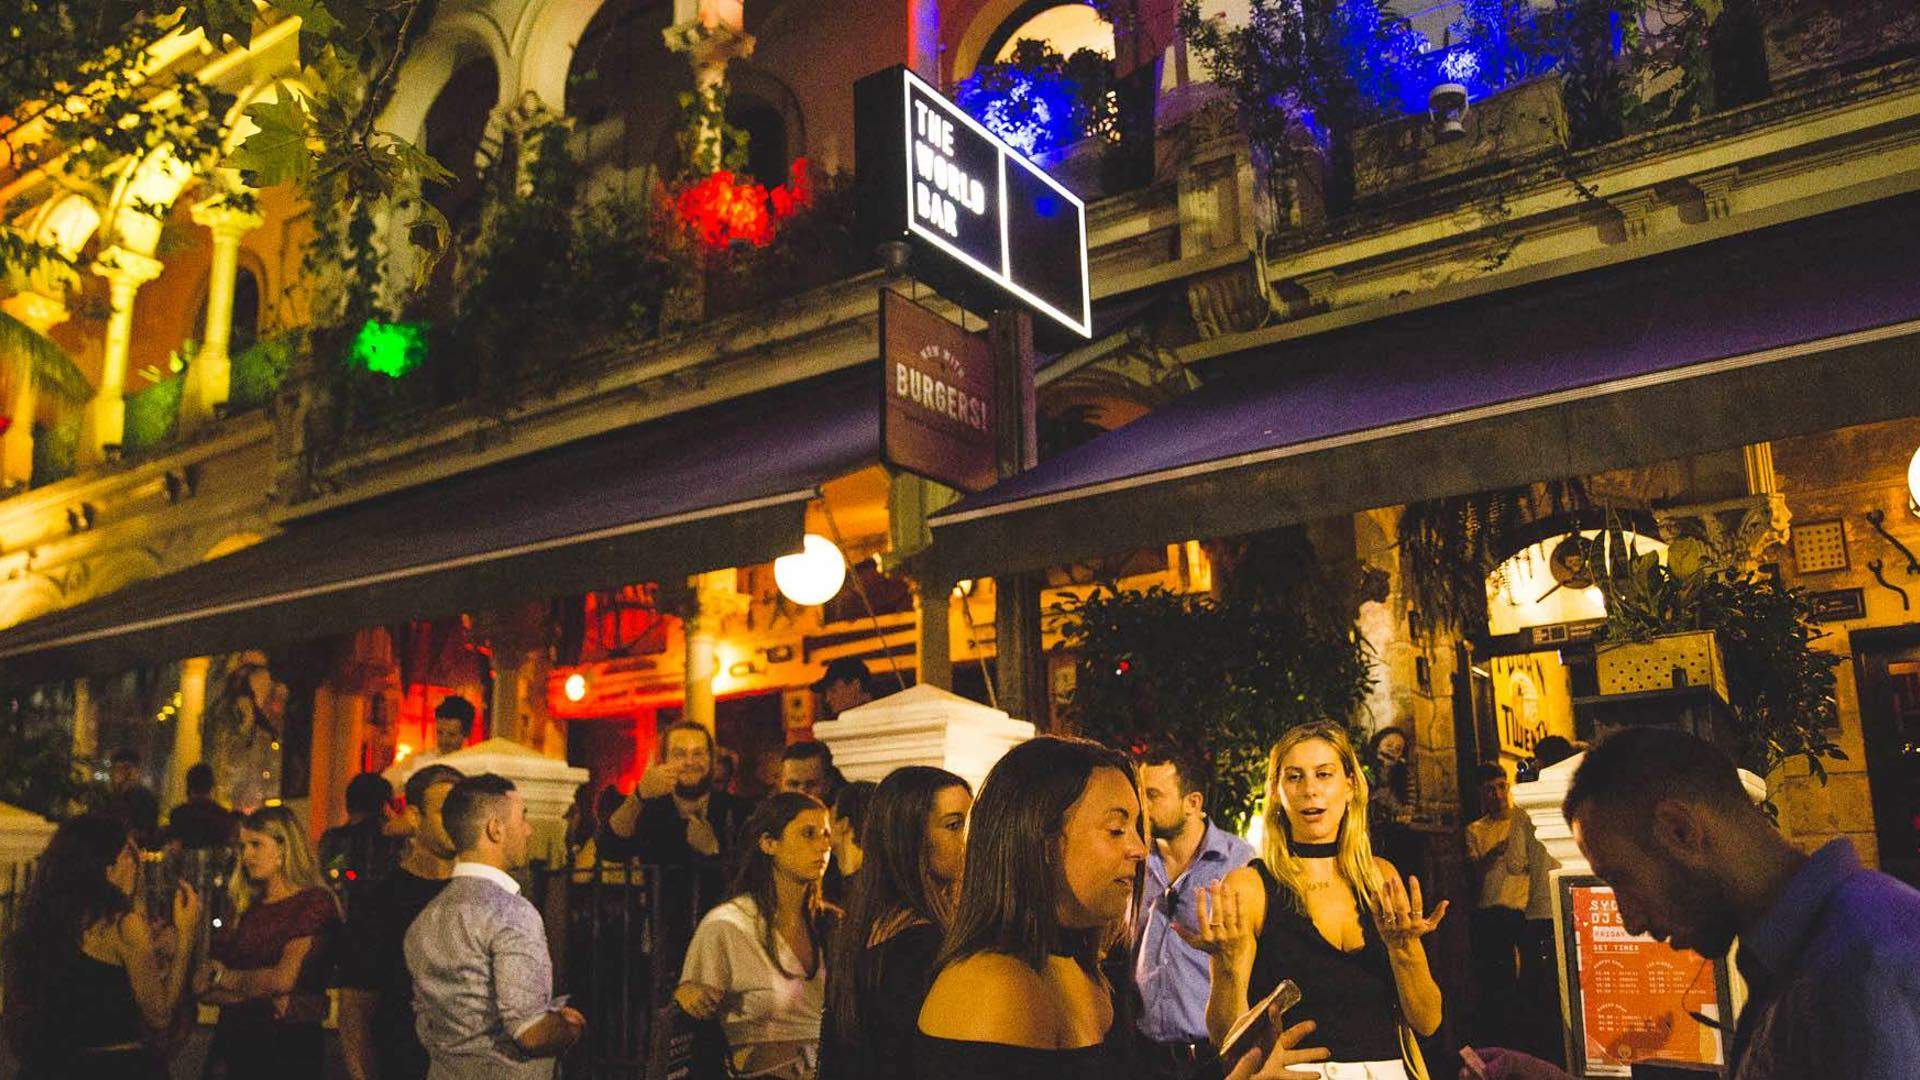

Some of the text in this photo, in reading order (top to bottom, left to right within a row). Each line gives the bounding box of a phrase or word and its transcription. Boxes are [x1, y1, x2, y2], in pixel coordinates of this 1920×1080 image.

[914, 99, 954, 156] THE
[914, 140, 986, 216] WORLD
[916, 181, 958, 237] BAR
[896, 362, 989, 431] BURGERS!
[1591, 912, 1610, 924] DJ
